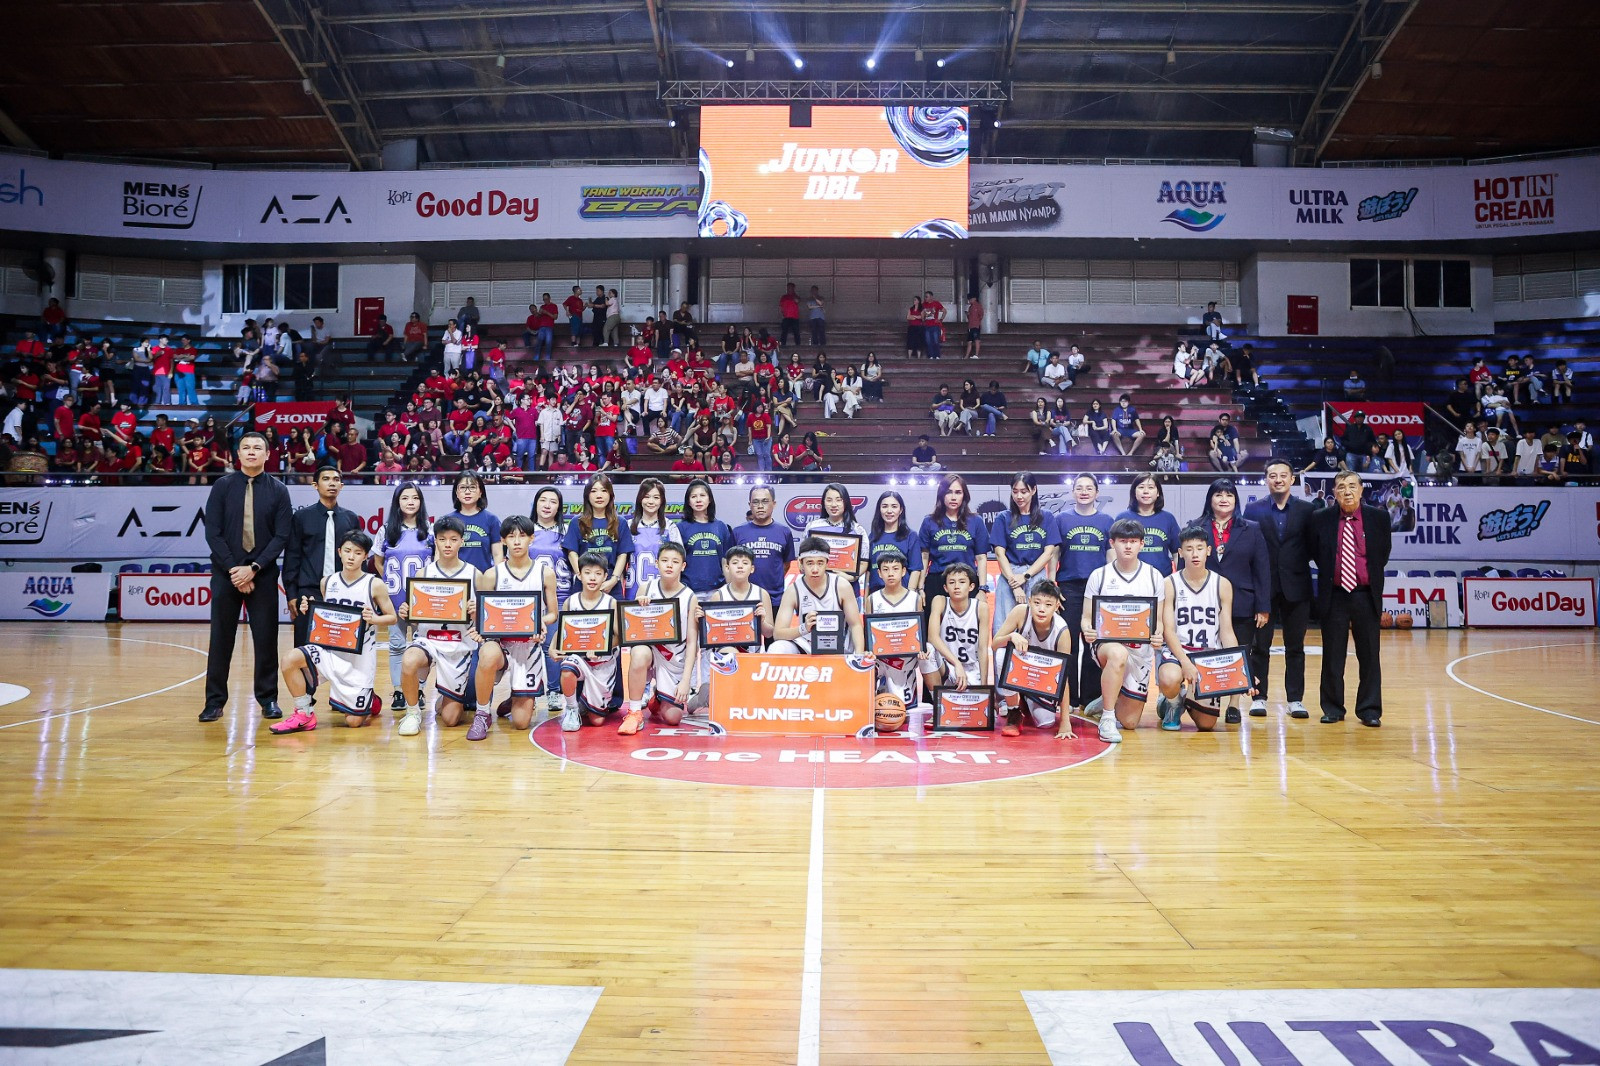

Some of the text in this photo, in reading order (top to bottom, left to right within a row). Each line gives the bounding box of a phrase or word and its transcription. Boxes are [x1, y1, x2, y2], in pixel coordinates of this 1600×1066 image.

[763, 143, 899, 173] JUNIOR
[583, 187, 617, 198] YANG
[619, 187, 665, 197] WORTH
[803, 175, 863, 200] DBL
[1157, 180, 1227, 208] AQUA
[1474, 174, 1553, 201] HOT IN
[123, 197, 188, 218] Bioré
[416, 191, 482, 218] Good
[488, 190, 539, 223] Day
[1289, 190, 1349, 206] ULTRA
[989, 208, 1018, 224] MAKIN
[1296, 208, 1344, 224] MILK
[1475, 198, 1554, 223] CREAM
[275, 413, 328, 424] HOND
[1416, 503, 1467, 522] LTRA
[1405, 526, 1461, 544] MILK
[23, 575, 74, 598] AQUA
[145, 586, 195, 606] Good
[1381, 588, 1446, 604] HM
[1491, 591, 1543, 611] Good
[1546, 591, 1585, 616] Day
[1177, 606, 1216, 626] SCS
[945, 625, 978, 644] SCS
[1187, 629, 1208, 648] 14
[526, 673, 536, 688] 3
[751, 662, 833, 683] JUNIOR
[773, 683, 810, 700] DBL
[903, 687, 912, 701] 5
[355, 695, 366, 708] 8
[729, 707, 853, 722] RUNNER-UP
[630, 747, 762, 763] One
